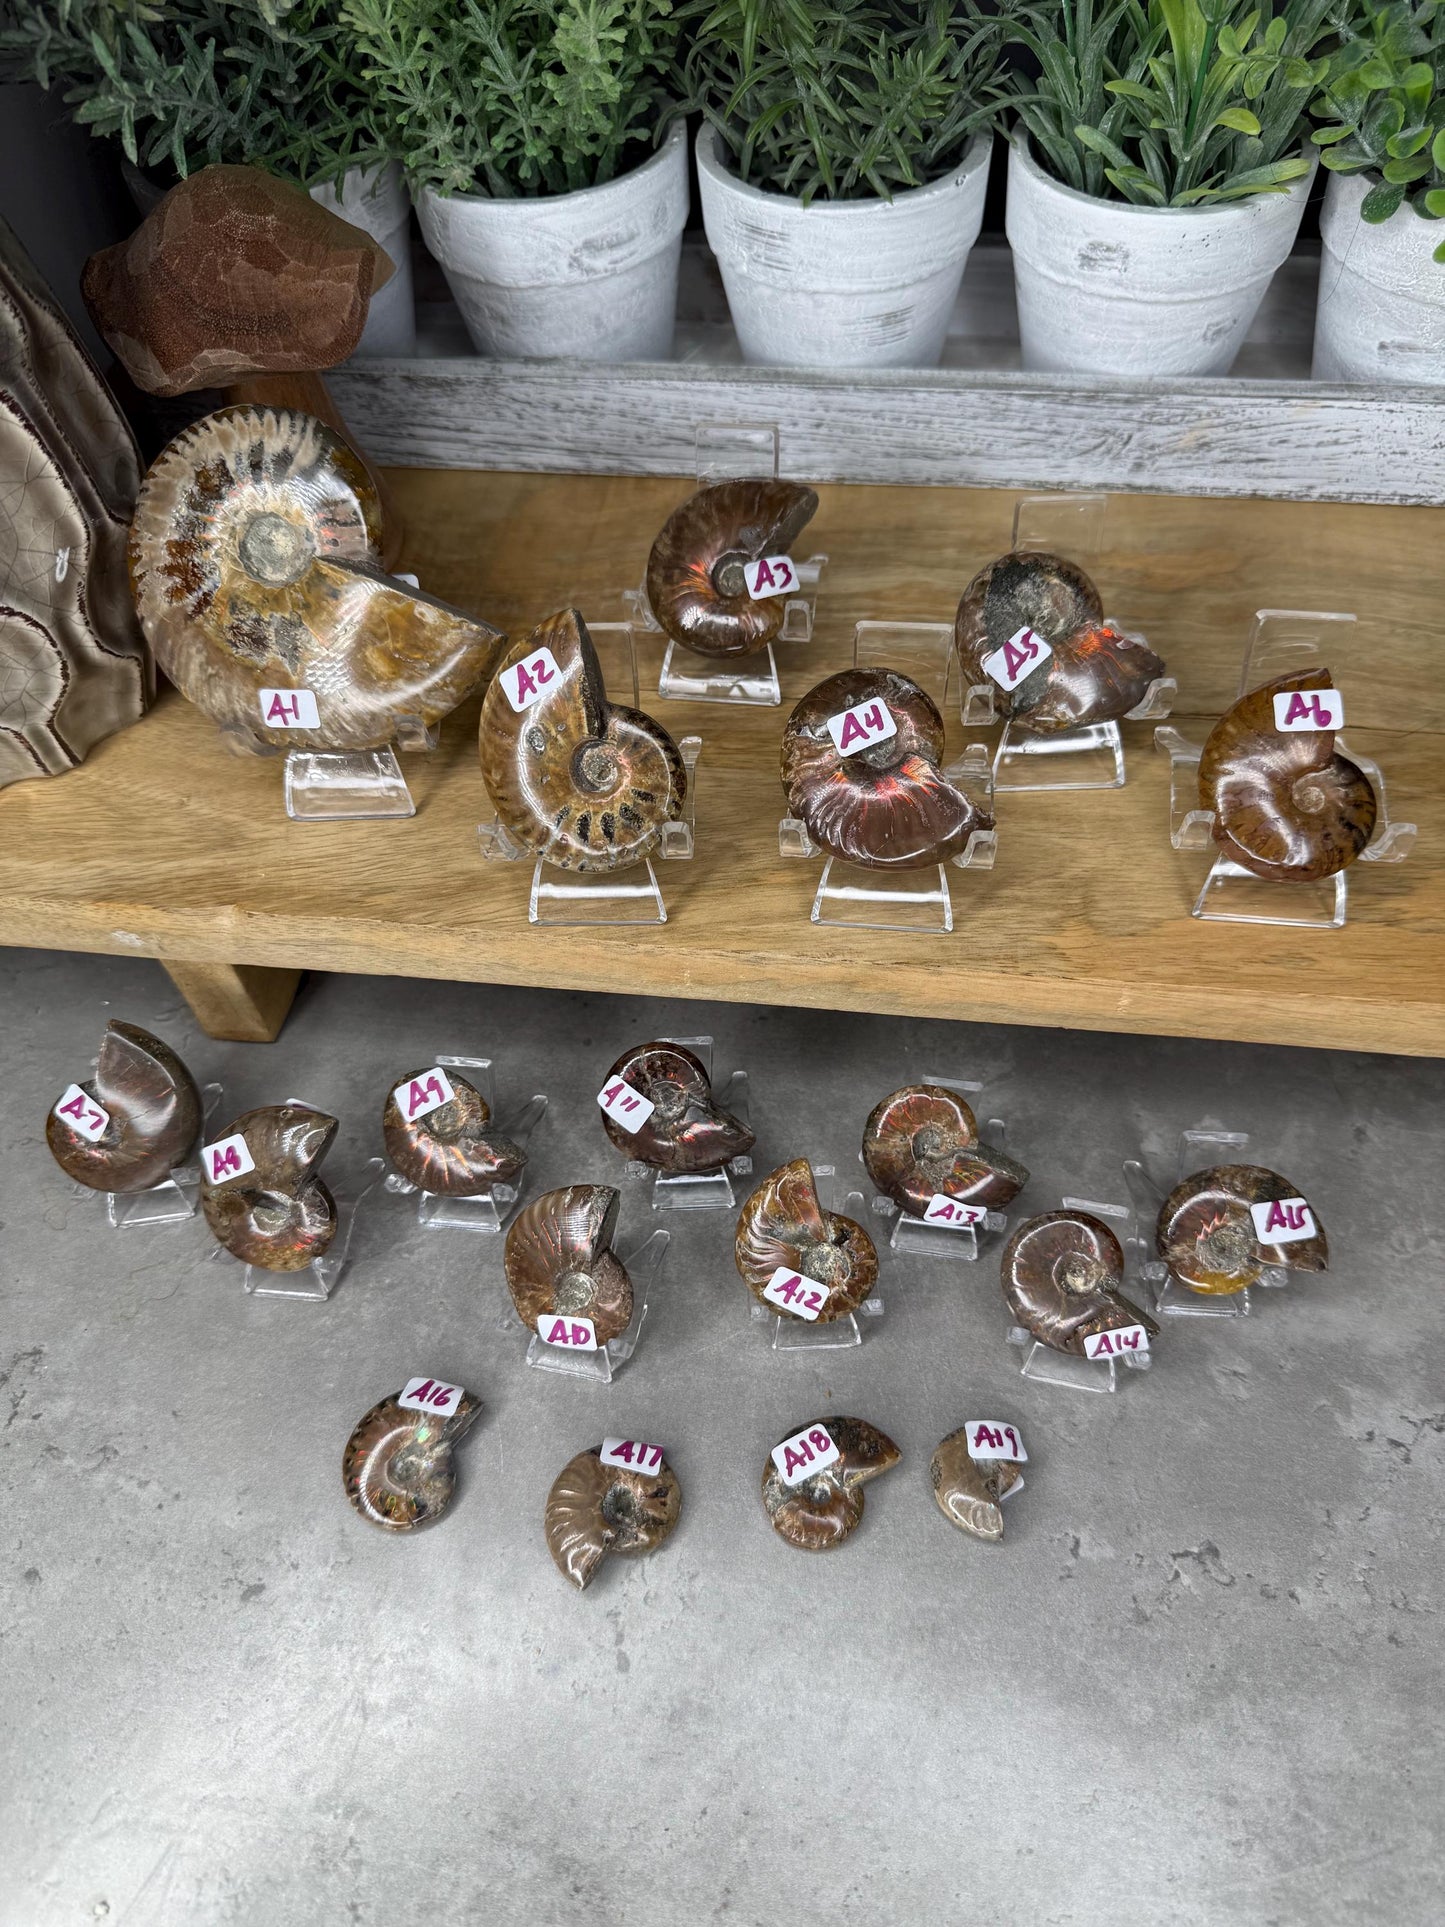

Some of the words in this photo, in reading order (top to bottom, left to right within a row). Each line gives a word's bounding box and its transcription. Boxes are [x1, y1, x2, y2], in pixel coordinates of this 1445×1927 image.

[754, 560, 791, 591] A3
[1004, 630, 1038, 680] A5
[517, 660, 553, 703] A2
[268, 694, 299, 726] A1
[1285, 693, 1331, 727] A6
[841, 705, 883, 749] A4
[60, 1096, 104, 1130] A7
[409, 1077, 444, 1117] A9
[603, 1083, 641, 1112] A11
[214, 1146, 241, 1179] A8
[929, 1203, 979, 1223] A13
[1267, 1200, 1310, 1232] A15
[774, 1276, 822, 1313] A12
[1091, 1332, 1140, 1357] A14
[407, 1380, 454, 1406] A16
[610, 1441, 664, 1467] A17
[782, 1431, 830, 1477] A18
[975, 1426, 1018, 1456] A19
